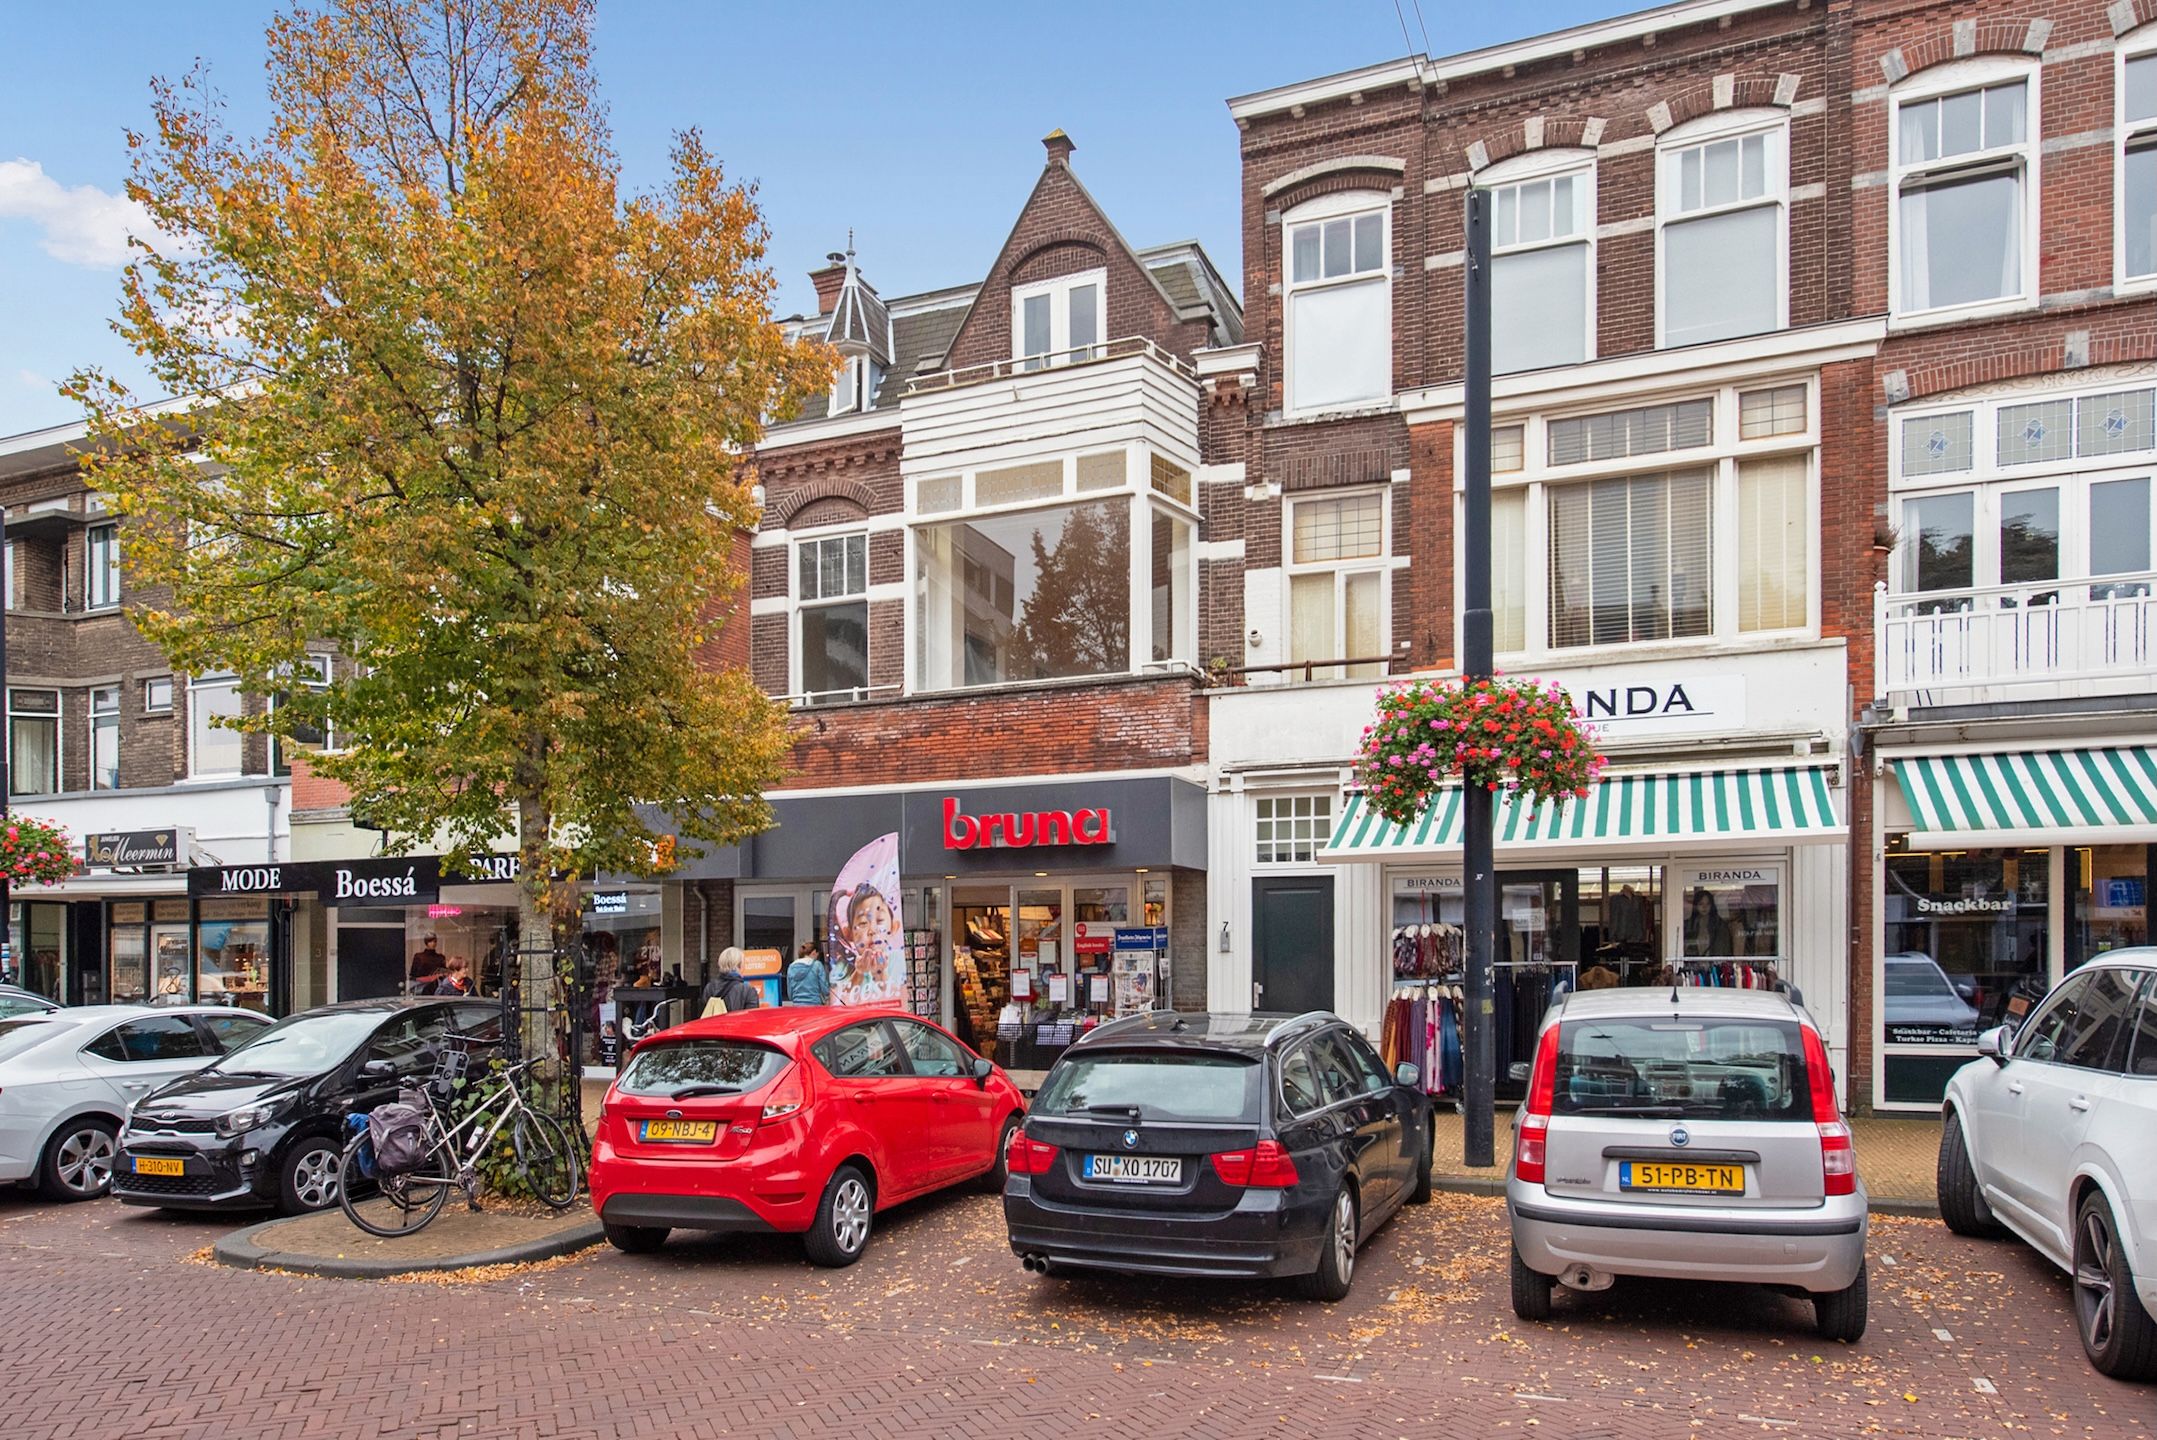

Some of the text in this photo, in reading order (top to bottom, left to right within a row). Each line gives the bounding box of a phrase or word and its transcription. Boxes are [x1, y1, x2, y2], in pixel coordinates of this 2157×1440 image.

[943, 797, 1112, 850] bruna
[101, 836, 174, 862] Meermin
[221, 867, 281, 891] MODE
[335, 866, 417, 898] Boessá
[1407, 879, 1461, 887] BIRANDA
[1699, 871, 1761, 880] BIRANDA
[593, 892, 627, 905] Boessá
[1917, 898, 2012, 913] Snackbar
[1222, 920, 1229, 932] 7
[651, 1121, 711, 1137] 09-NBJ-4
[138, 1159, 180, 1174] H-310-NV
[1094, 1157, 1112, 1175] SU
[1143, 1160, 1179, 1178] 1707
[1641, 1166, 1733, 1187] 51-PB-TN
